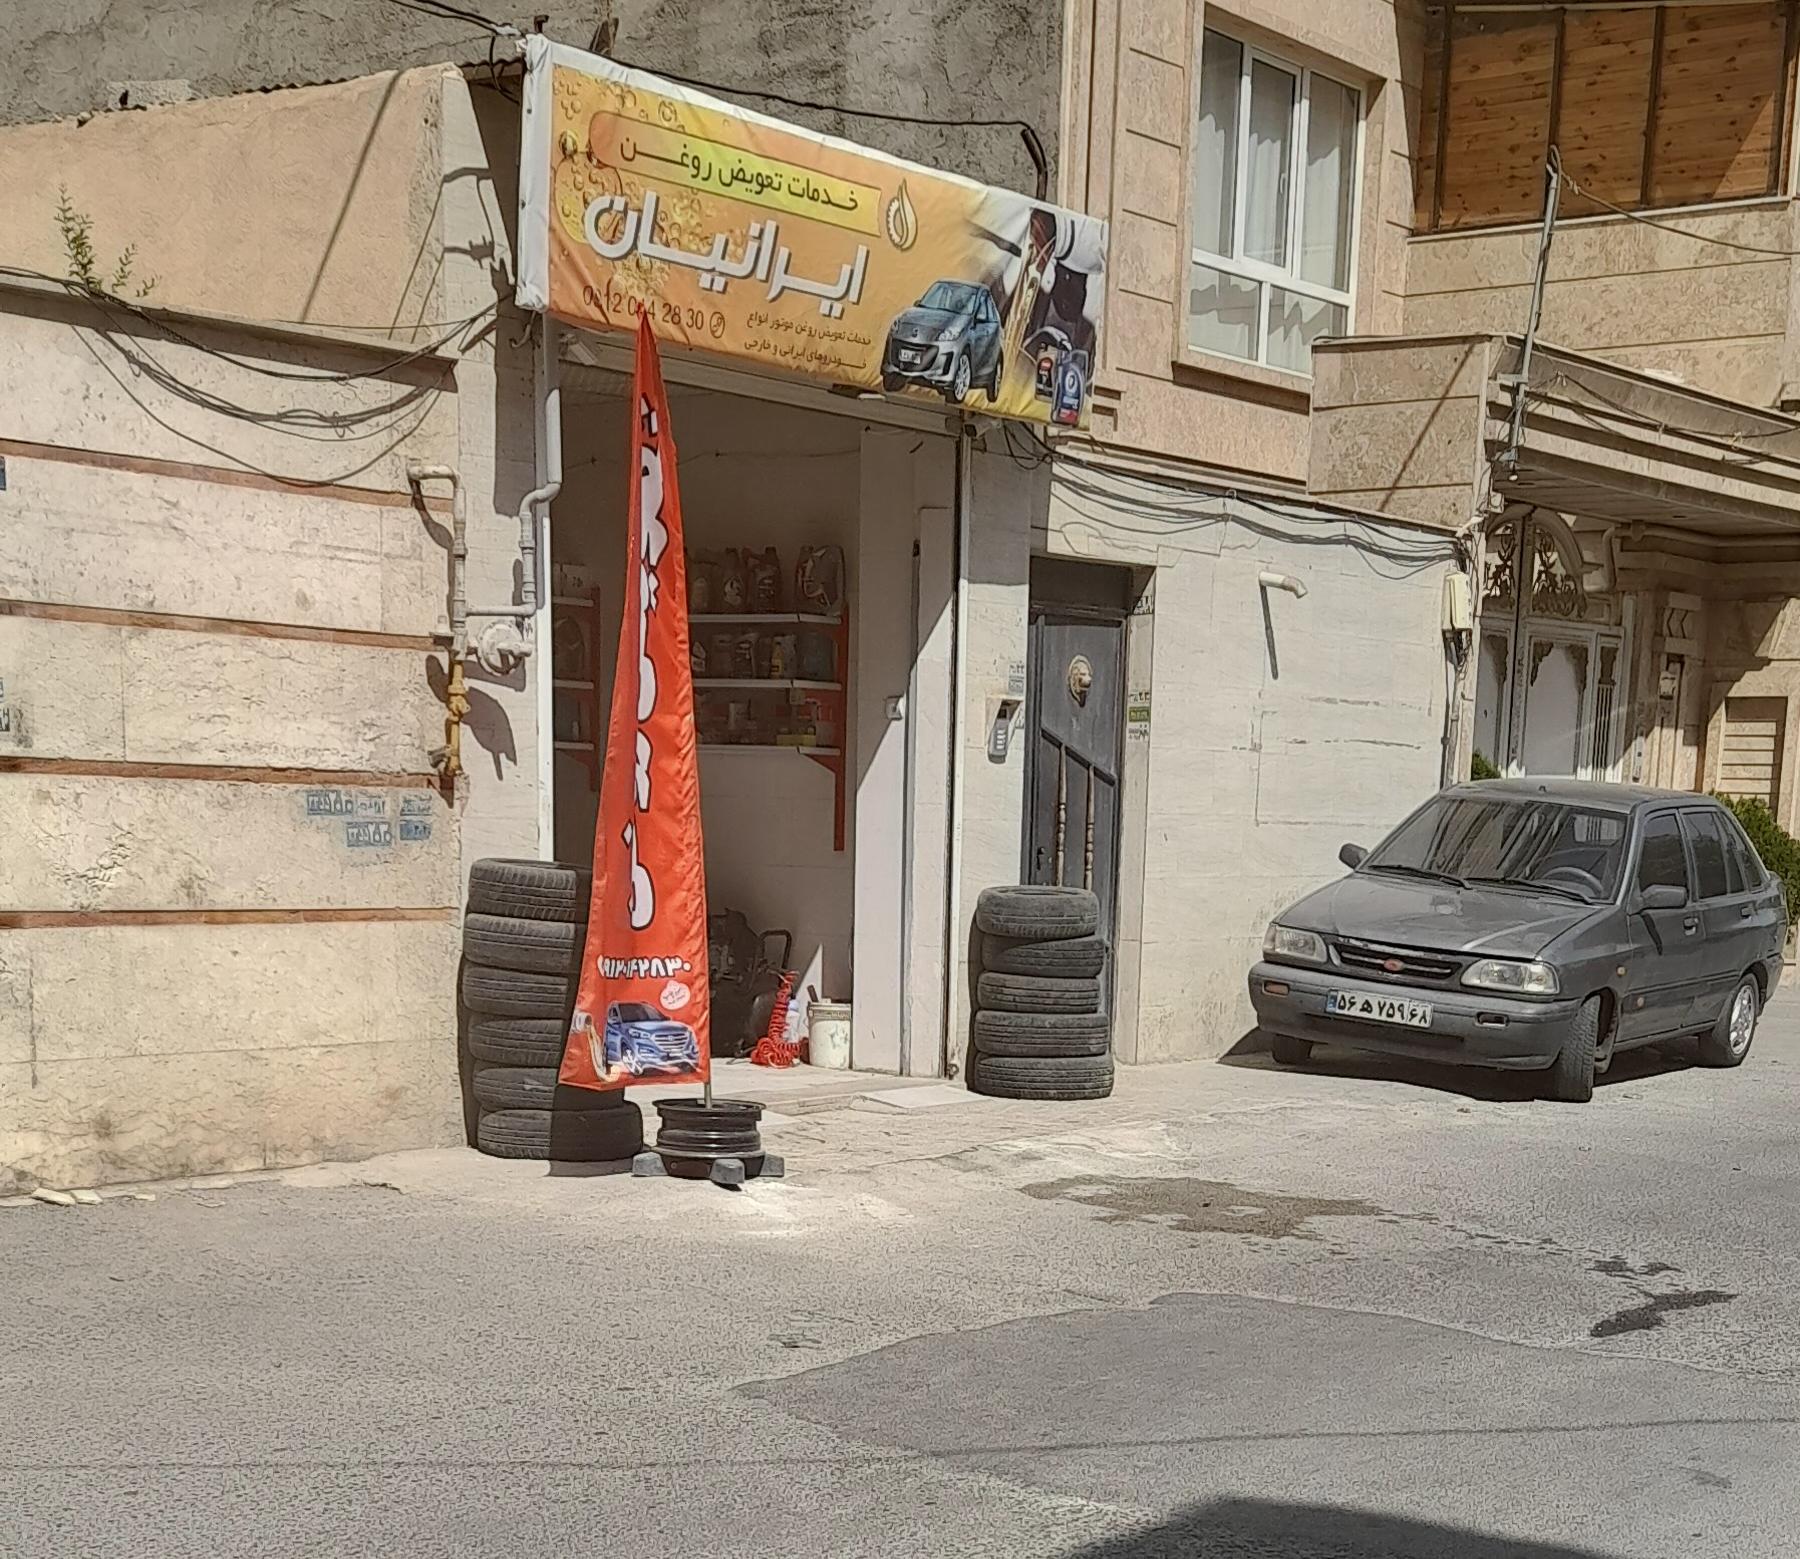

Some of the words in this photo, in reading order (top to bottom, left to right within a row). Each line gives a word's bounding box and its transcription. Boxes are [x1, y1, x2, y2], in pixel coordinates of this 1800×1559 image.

[620, 137, 712, 181] روغن
[718, 159, 783, 195] تعویض
[788, 177, 859, 211] خدمات
[584, 190, 870, 320] ایرانیان
[627, 295, 656, 320] 04
[662, 302, 681, 325] 28
[686, 308, 704, 330] 30
